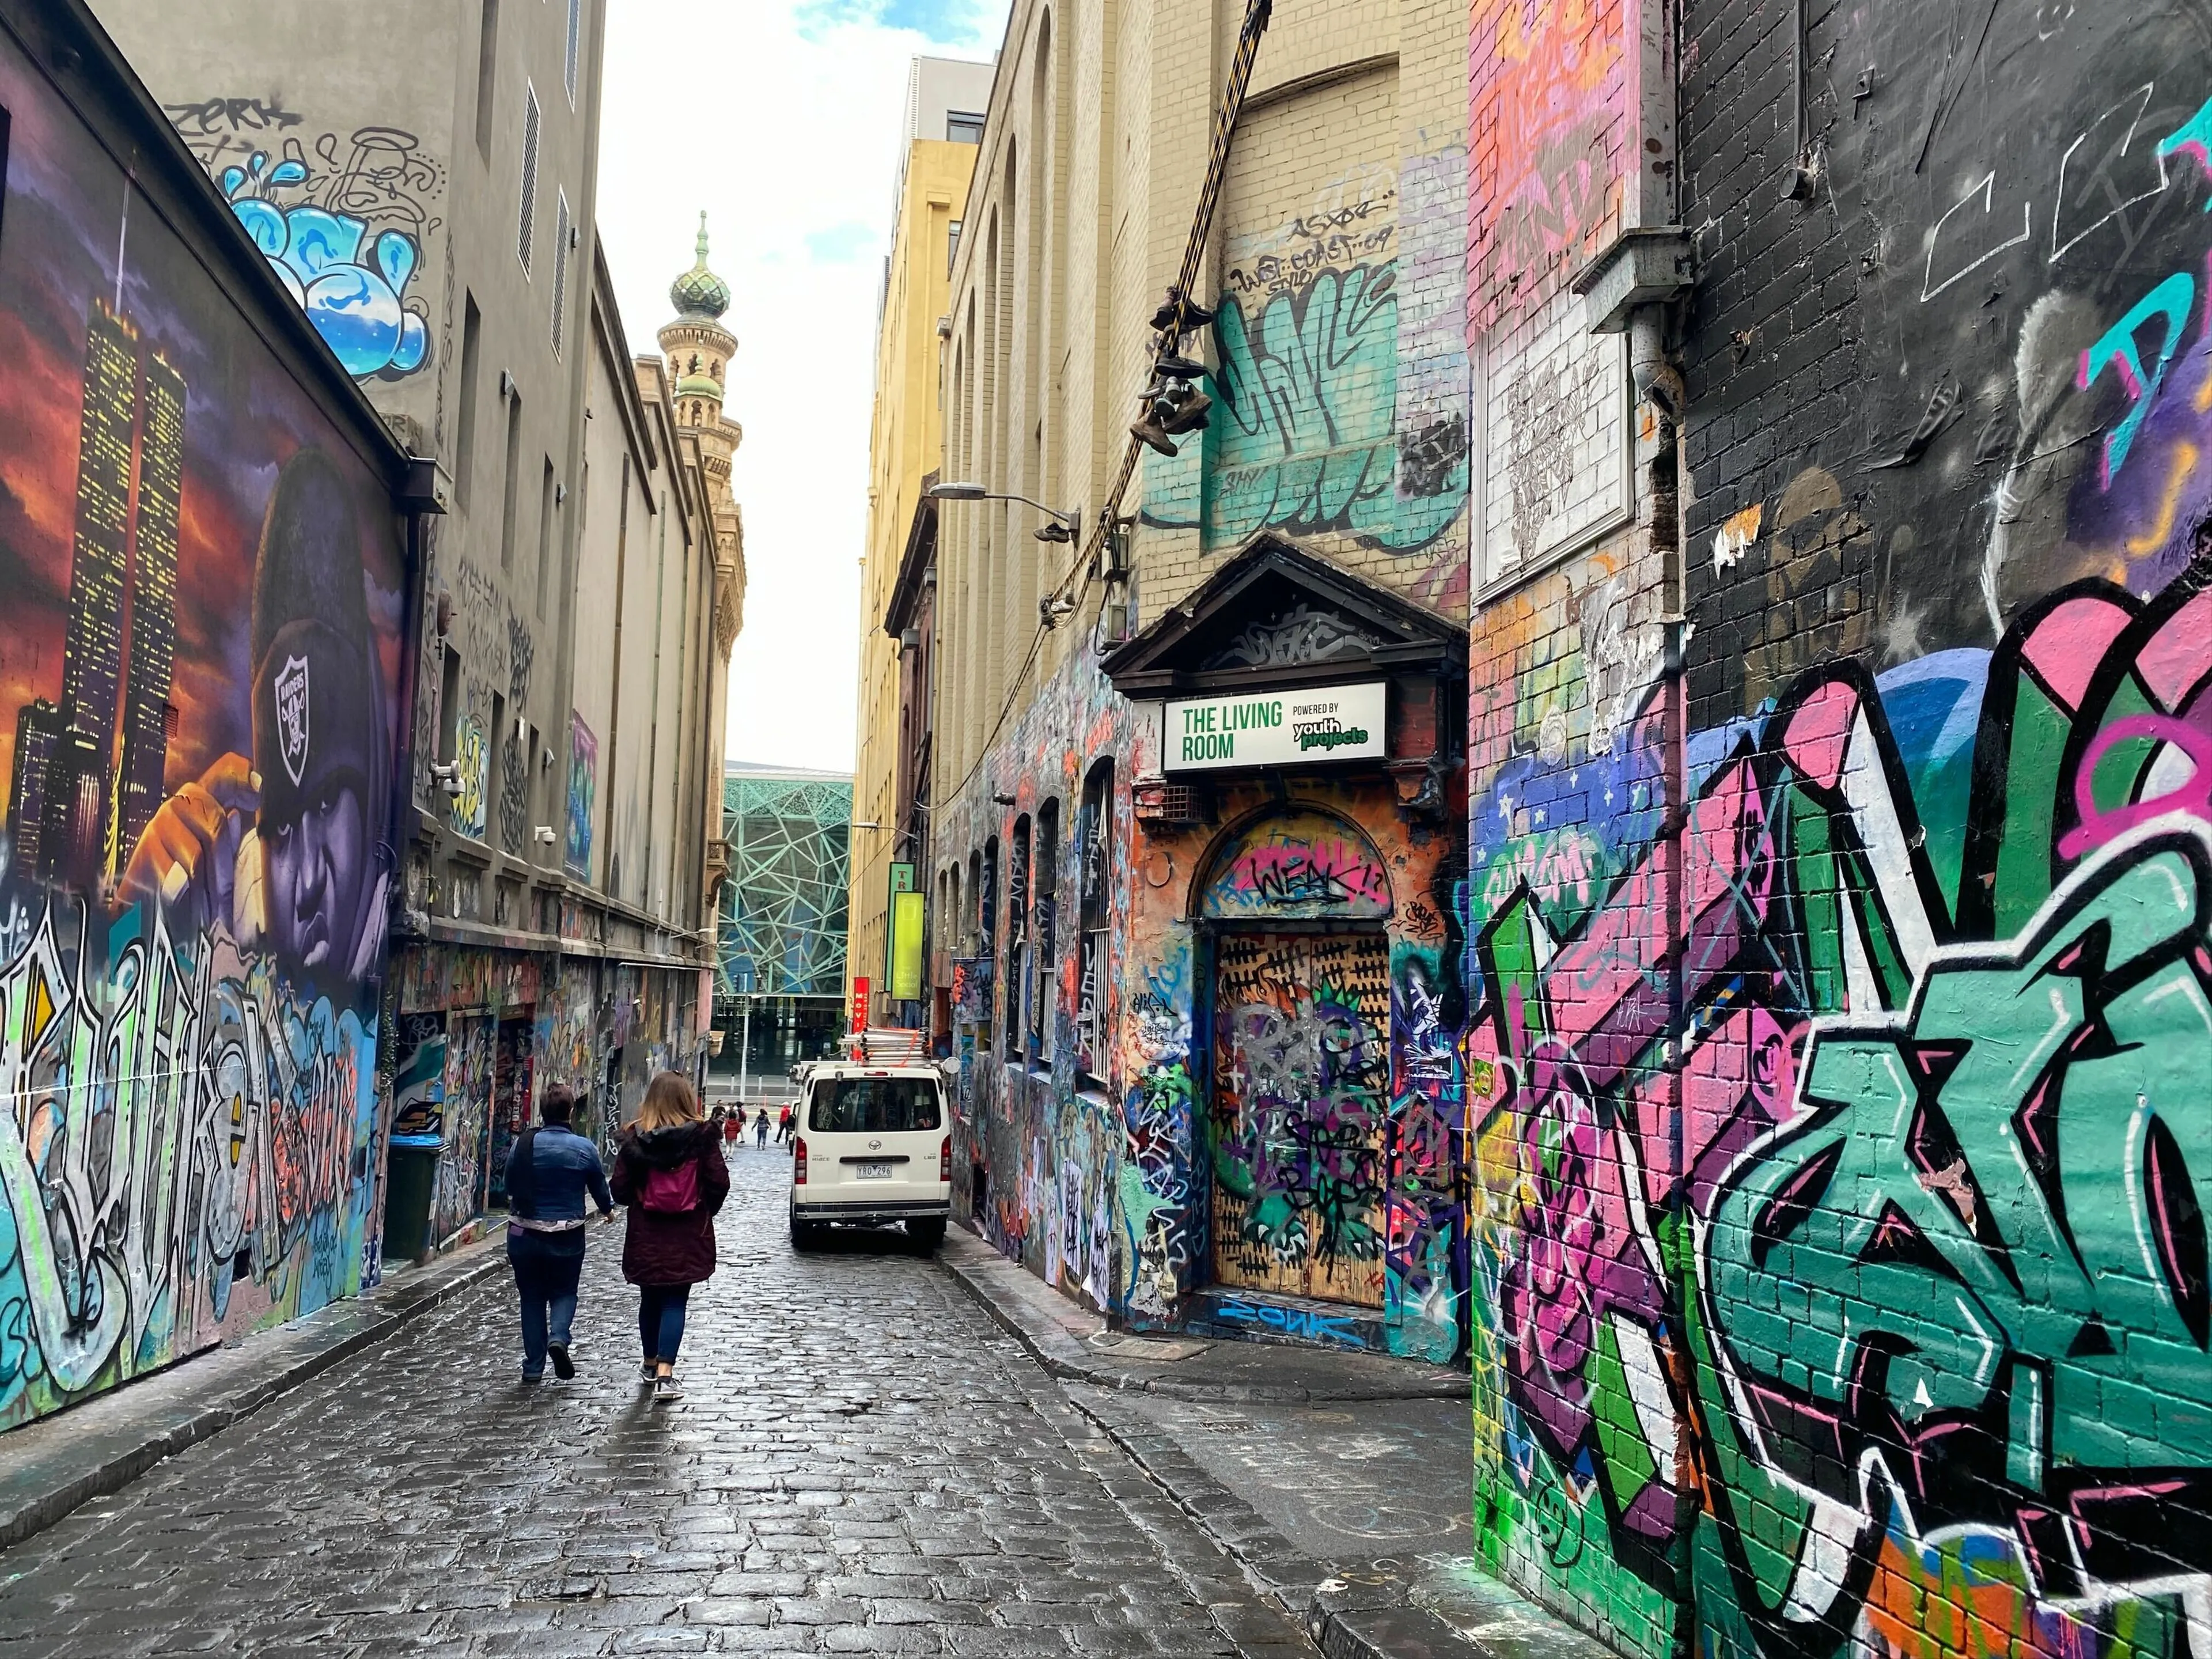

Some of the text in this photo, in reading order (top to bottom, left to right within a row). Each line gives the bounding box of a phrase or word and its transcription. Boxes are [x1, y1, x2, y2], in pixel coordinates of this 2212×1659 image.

[280, 672, 304, 702] RAIDERS
[1183, 700, 1282, 734] THE LIVING
[1293, 703, 1339, 715] POWERED BY
[1293, 718, 1342, 742] youth
[1301, 728, 1368, 752] projects
[1182, 733, 1234, 762] ROOM
[855, 993, 863, 1035] MOVI
[877, 1166, 891, 1175] 296
